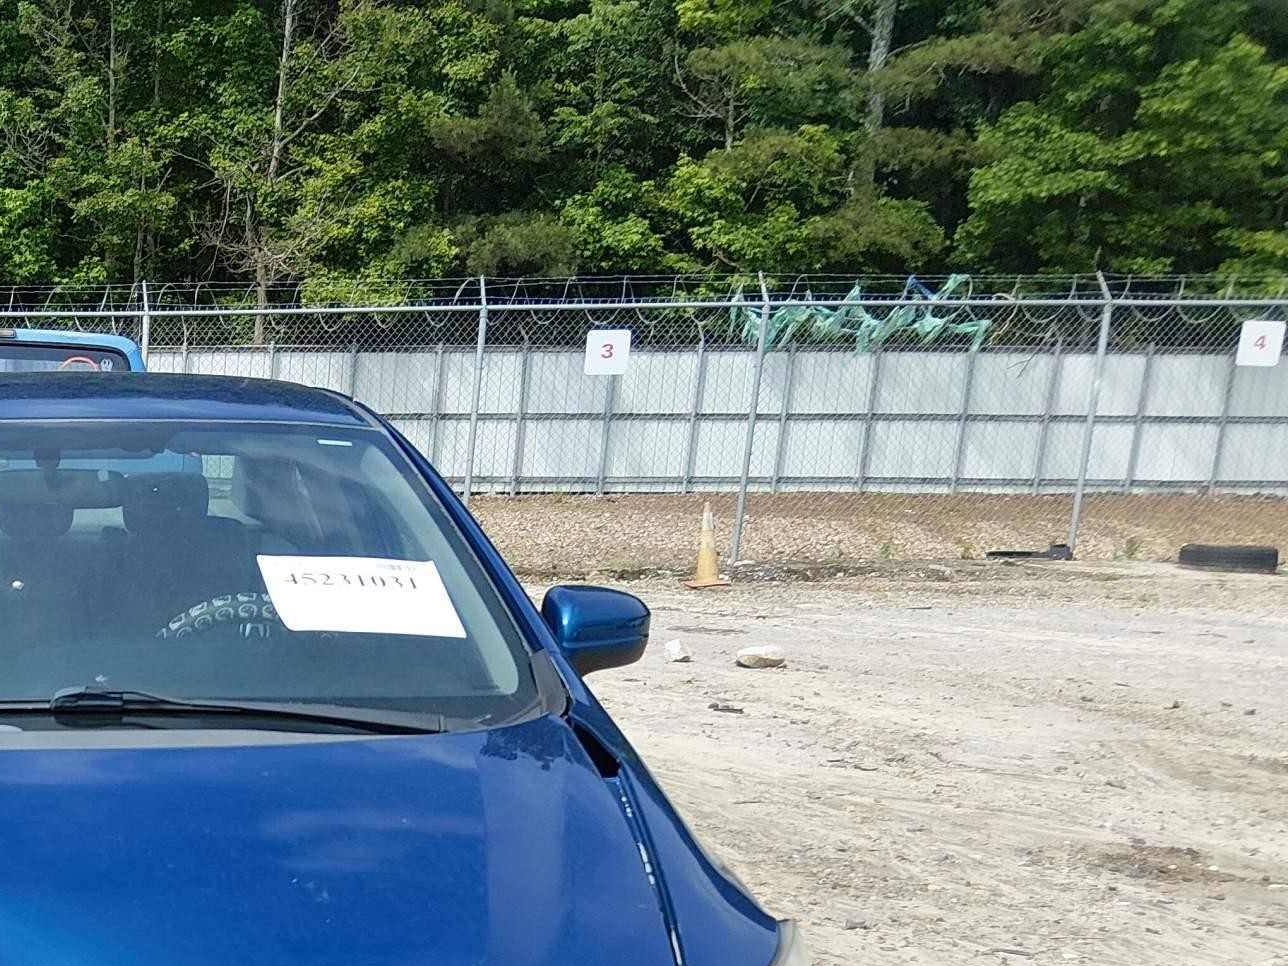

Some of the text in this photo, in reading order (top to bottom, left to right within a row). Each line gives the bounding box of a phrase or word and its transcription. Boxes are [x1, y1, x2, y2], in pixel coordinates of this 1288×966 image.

[1254, 335, 1267, 350] 4
[601, 343, 614, 359] 3
[284, 572, 418, 590] 45231031
